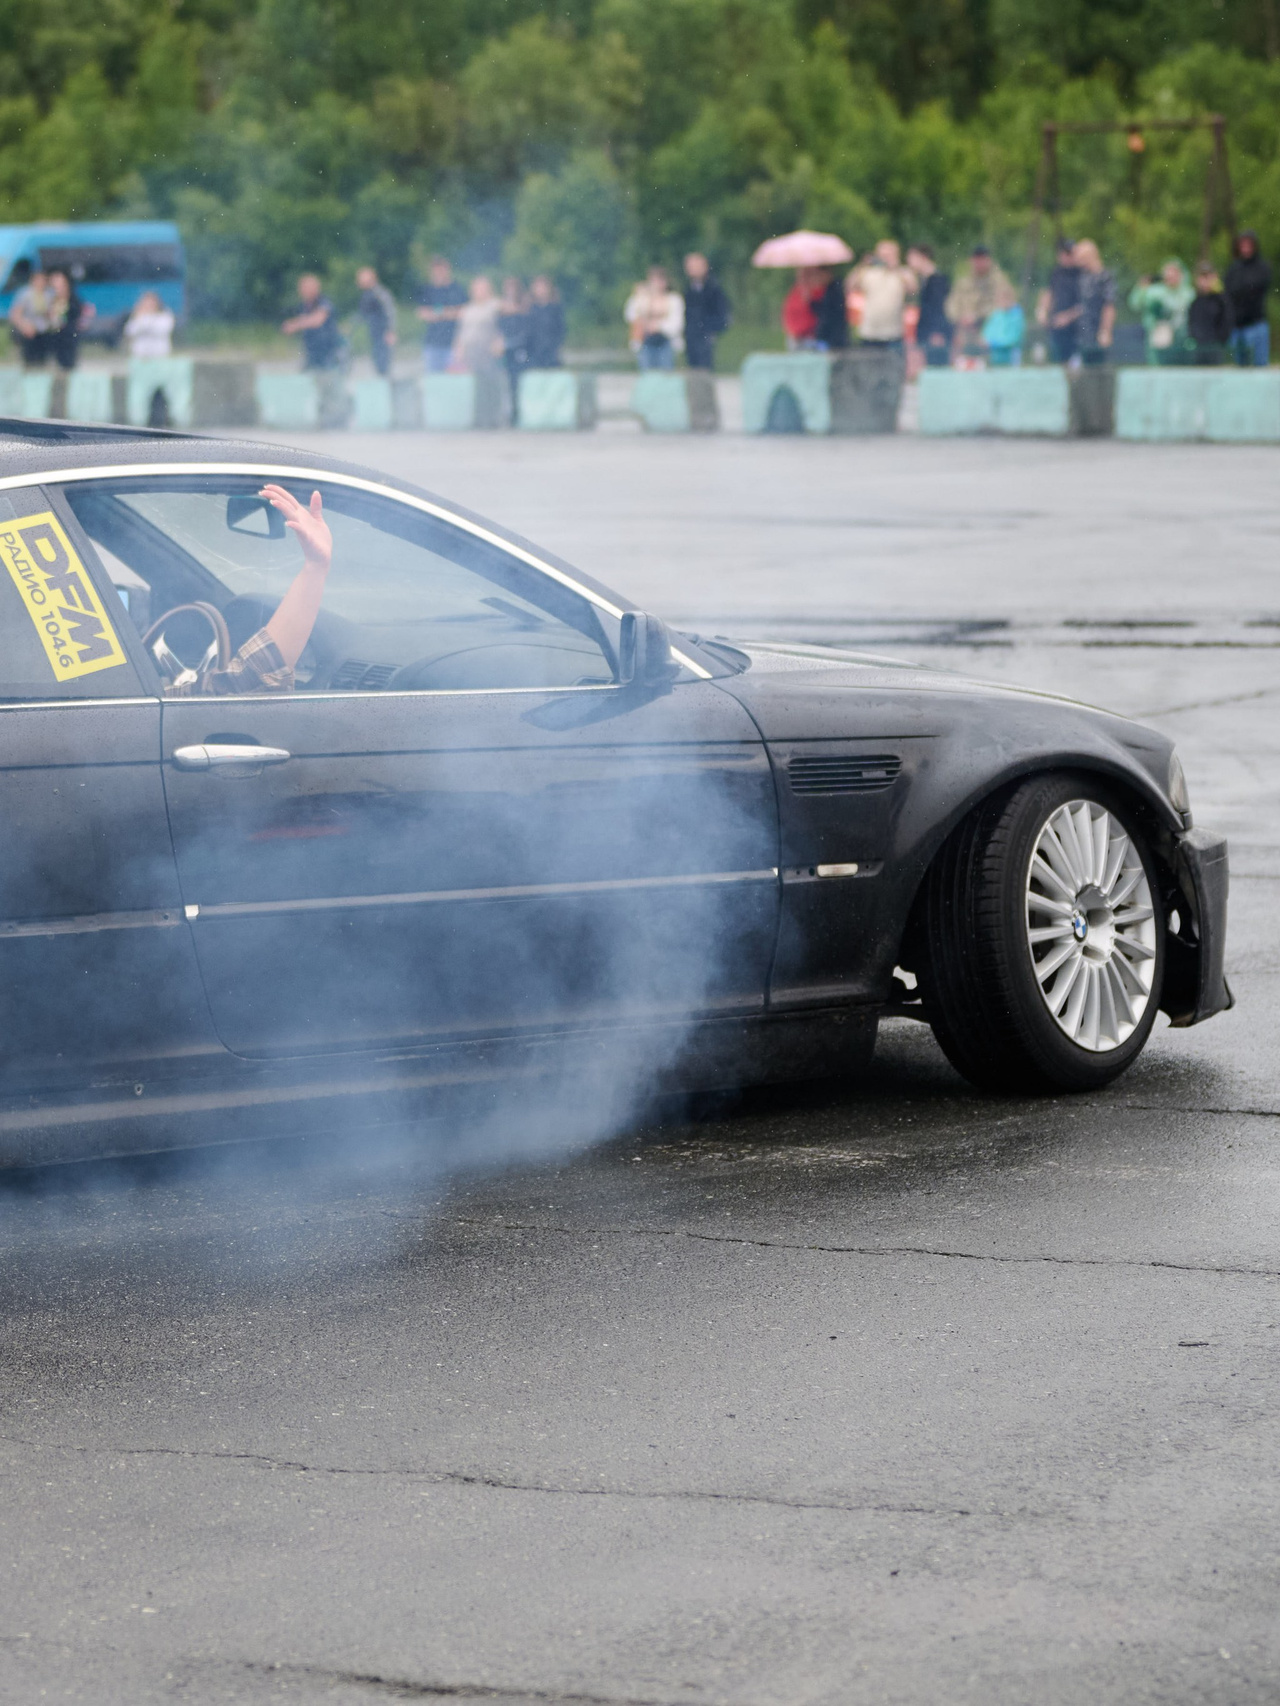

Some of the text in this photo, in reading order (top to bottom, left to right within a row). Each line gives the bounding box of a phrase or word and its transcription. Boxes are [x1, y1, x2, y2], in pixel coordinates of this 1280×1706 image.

[0, 532, 74, 668] РАДИО 104.6
[17, 523, 114, 663] DFM
